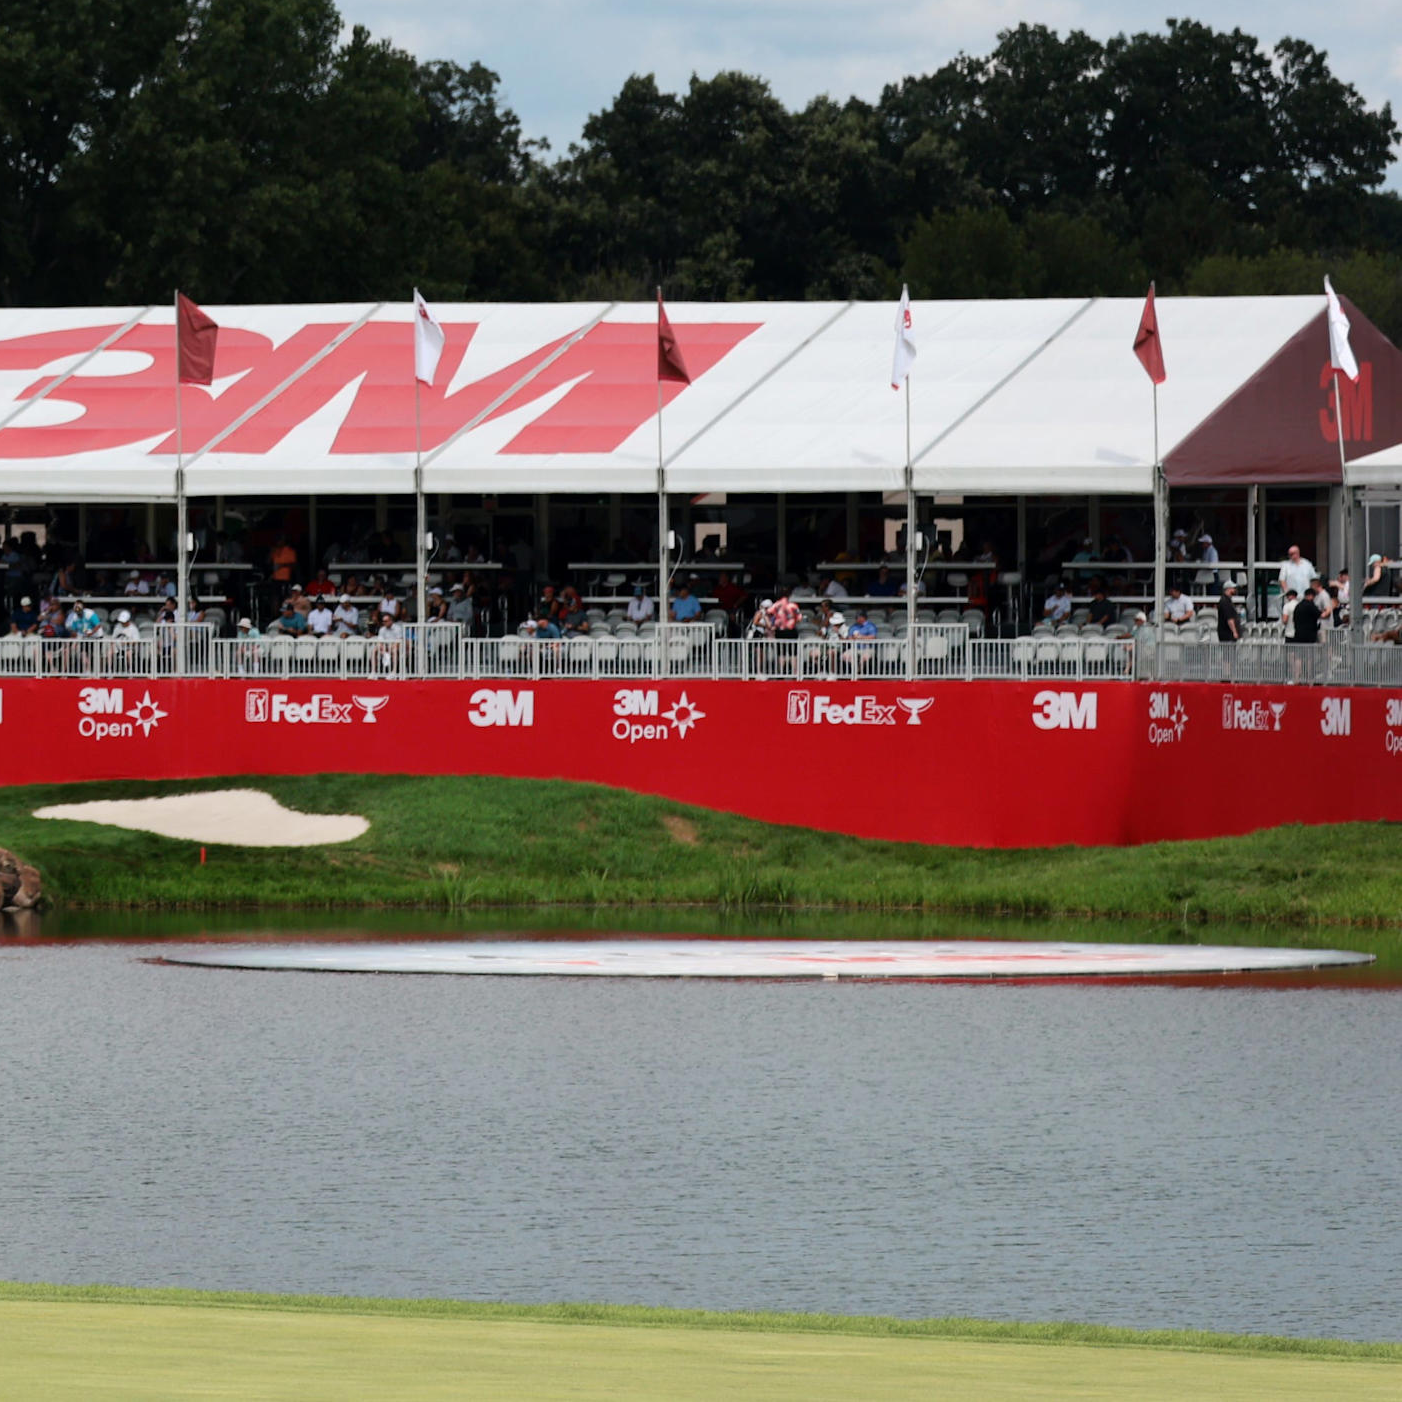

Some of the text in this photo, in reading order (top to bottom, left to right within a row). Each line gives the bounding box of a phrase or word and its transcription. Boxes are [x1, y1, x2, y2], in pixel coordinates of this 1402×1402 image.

[1319, 360, 1373, 443] 3M
[78, 687, 123, 715] 3M
[271, 693, 353, 724] FedEx
[468, 689, 534, 727] 3M
[613, 689, 659, 716] 3M
[813, 695, 896, 725] FedEx
[1032, 691, 1098, 730] 3M
[1149, 692, 1169, 719] 3M
[1234, 699, 1270, 731] FedEx
[78, 715, 134, 740] Open
[613, 717, 669, 743] Open
[1321, 697, 1351, 736] 3M
[1148, 722, 1174, 747] Open
